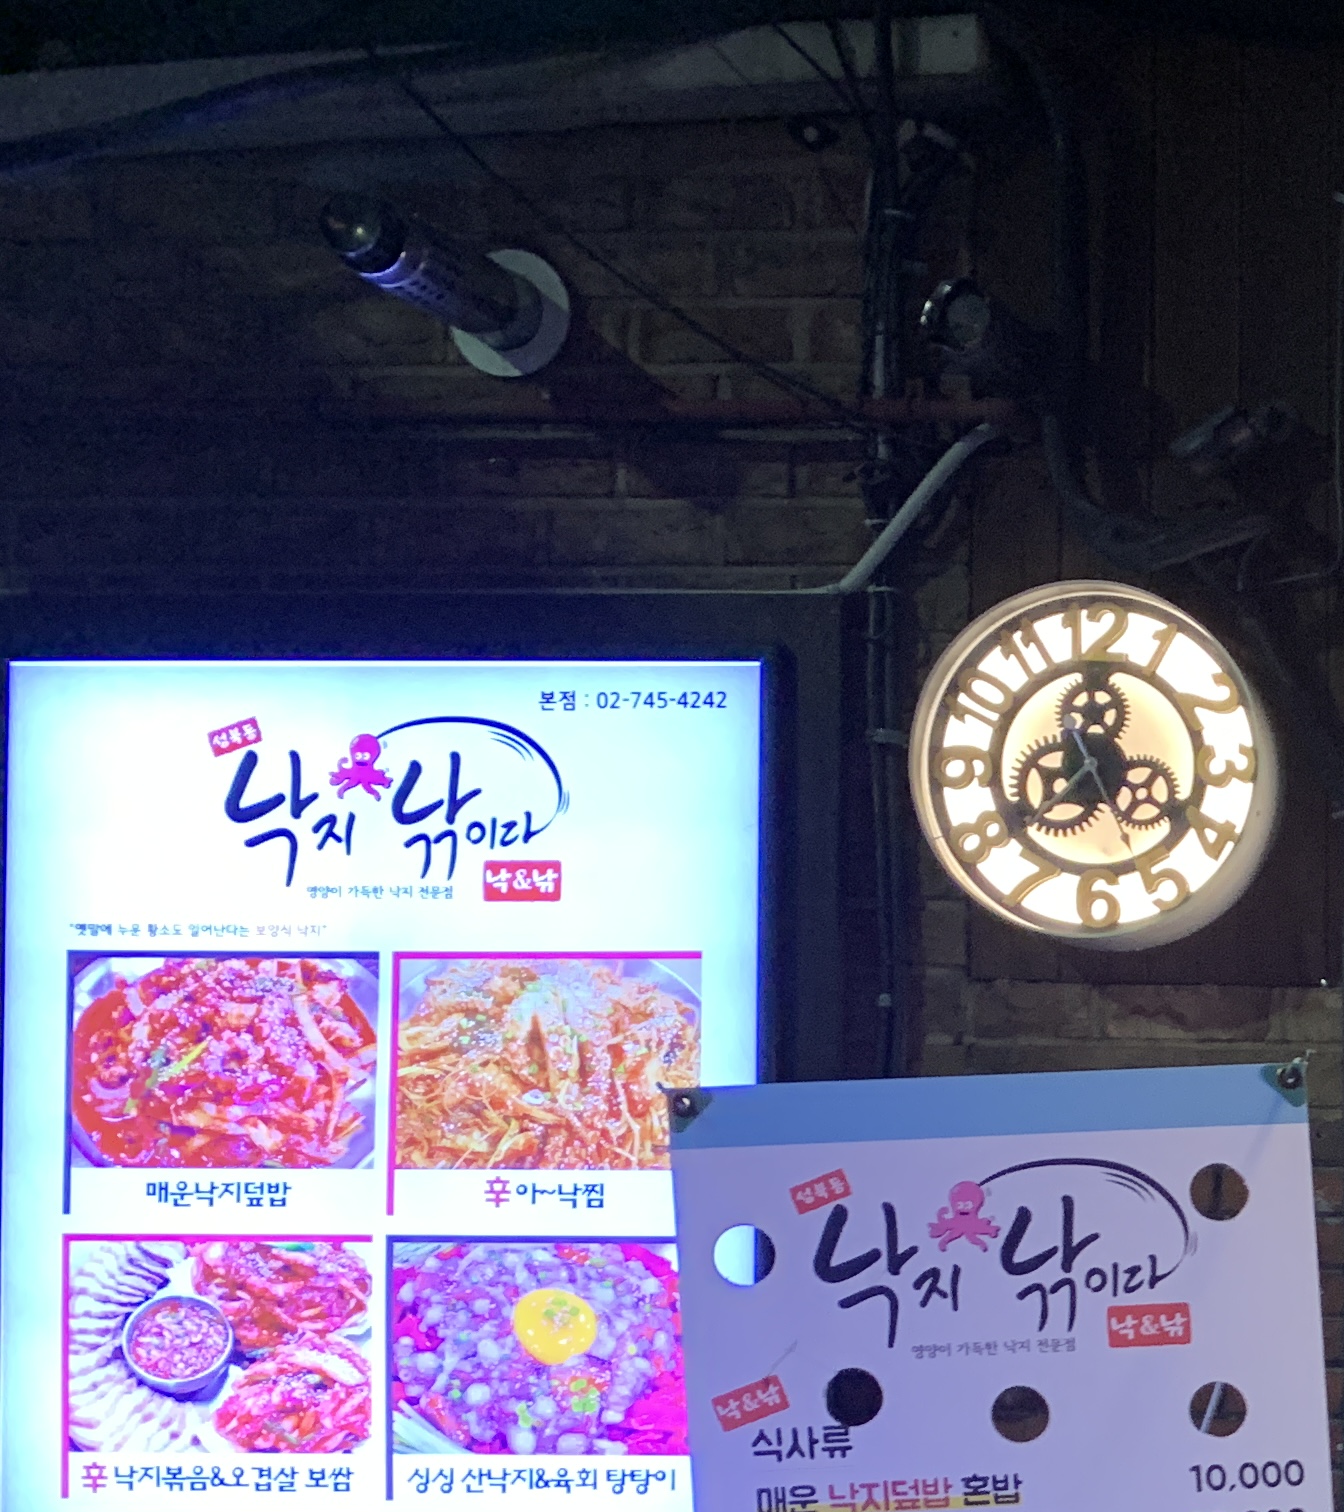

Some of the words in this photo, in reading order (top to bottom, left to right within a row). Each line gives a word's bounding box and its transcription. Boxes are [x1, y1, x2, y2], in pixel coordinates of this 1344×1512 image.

[1000, 619, 1057, 682] 11
[1062, 602, 1129, 662] 12
[1143, 622, 1178, 678] 1
[539, 690, 577, 711] 본점
[597, 690, 728, 710] 02-745-4242
[947, 667, 1014, 726] 10
[1175, 672, 1240, 731] 2
[935, 745, 993, 789] 9
[1196, 742, 1257, 786] 3
[224, 750, 355, 887] 낙지
[391, 751, 541, 880] 낚이다
[949, 810, 1009, 864] 8
[1186, 804, 1241, 862] 4
[347, 885, 384, 899] 가득한
[389, 885, 413, 899] 낙지
[418, 885, 454, 899] 전문점
[486, 866, 557, 893] 낙&낚
[1002, 847, 1061, 908] 7
[1076, 868, 1120, 929] 6
[1135, 847, 1192, 912] 5
[146, 1181, 292, 1208] 매운낙지덮밥
[484, 1177, 511, 1208] 辛
[814, 1203, 961, 1349] 낙지
[1000, 1196, 1168, 1333] 낚이다
[1003, 1339, 1031, 1355] 낙지
[1036, 1337, 1077, 1355] 전문점
[1110, 1312, 1186, 1340] 낙&낚
[751, 1426, 855, 1463] 식사류
[82, 1462, 108, 1493] 辛
[114, 1466, 299, 1492] 낙지볶음&오겹살
[305, 1466, 354, 1492] 보쌈
[408, 1467, 456, 1494] 싱싱
[462, 1467, 598, 1493] 산낙지&육회
[605, 1467, 677, 1493] 탕탕이
[828, 1477, 953, 1512] 낙지덮밥
[961, 1473, 1023, 1507] 혼밥
[1190, 1461, 1304, 1495] 10,000
